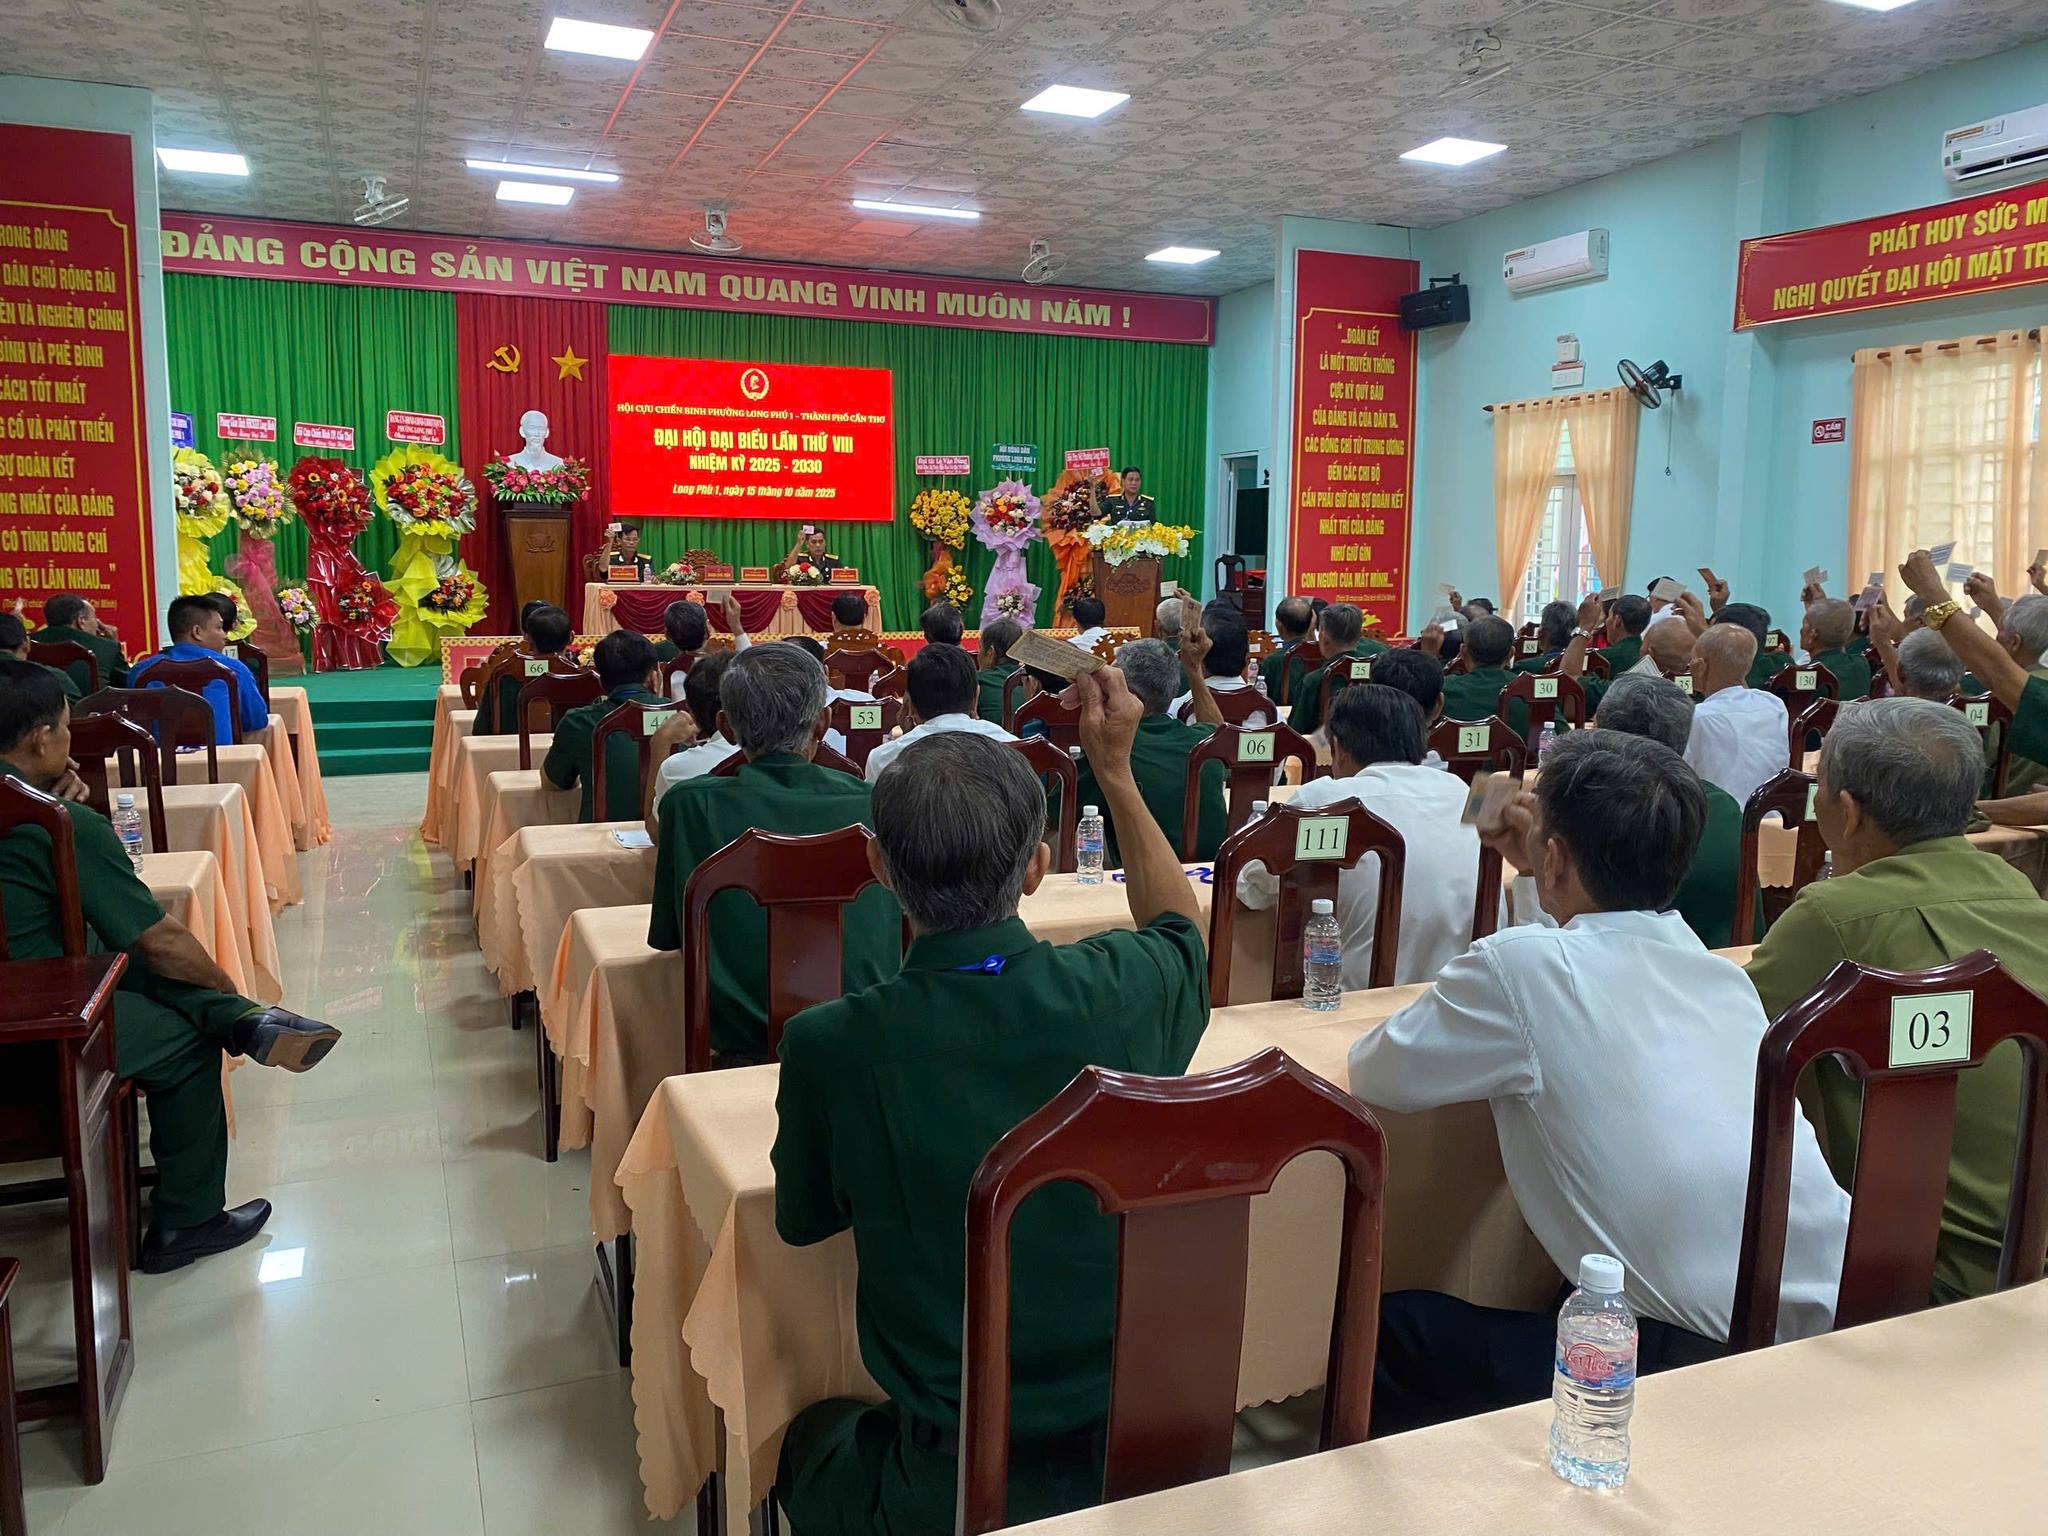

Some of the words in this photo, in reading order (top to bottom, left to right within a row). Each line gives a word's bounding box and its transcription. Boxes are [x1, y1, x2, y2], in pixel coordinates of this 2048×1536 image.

[34, 220, 69, 252] ĐẢNG
[1868, 223, 1920, 256] PHÁT
[1926, 213, 1968, 243] HUY
[1973, 201, 2019, 236] SỨC
[3, 259, 29, 287] DÂN
[32, 259, 56, 289] CHỦ
[59, 263, 93, 295] RỘNG
[95, 266, 117, 293] RÃI
[161, 223, 284, 265] ĐẢNG
[300, 239, 416, 276] CỘNG
[431, 245, 512, 282] SẢN
[526, 257, 609, 293] VIỆT
[622, 266, 706, 296] NAM
[719, 274, 837, 306] QUANG
[848, 284, 925, 313] VINH
[937, 291, 1031, 321] MUÔN
[1041, 298, 1111, 326] NĂM
[1773, 282, 1816, 311] NGHỊ
[1821, 264, 1882, 305] QUYẾT
[1885, 265, 1920, 296] ĐẠI
[1925, 253, 1961, 289] HỘI
[1967, 244, 2017, 282] MẶT
[18, 299, 35, 325] VÀ
[37, 301, 85, 329] NGHIÊM
[88, 301, 125, 331] CHỈNH
[1367, 325, 1380, 346] KẾT
[28, 337, 46, 365] VÀ
[48, 339, 72, 366] PHÊ
[74, 340, 104, 367] BÌNH
[1320, 351, 1329, 370] LÀ
[1330, 351, 1344, 374] MỘT
[1373, 352, 1395, 374] THỐNG
[30, 372, 50, 402] TỐT
[55, 375, 86, 404] NHẤT
[1330, 382, 1344, 402] CỰC
[617, 402, 634, 415] HỘI
[635, 405, 654, 414] CỰU
[655, 402, 683, 415] CHIẾN
[684, 407, 707, 415] BINH
[708, 406, 745, 418] PHƯỜNG
[746, 410, 769, 418] LONG
[770, 409, 789, 420] PHÚ
[801, 411, 831, 421] THÀNH
[832, 411, 849, 422] PHỐ
[850, 411, 868, 423] CẦN
[868, 414, 886, 424] THƠ
[1313, 403, 1326, 425] CỦA
[1328, 405, 1347, 427] ĐẢNG
[1348, 408, 1357, 427] VÀ
[1359, 406, 1372, 427] CỦA
[1374, 409, 1387, 428] DÂN
[27, 413, 44, 440] VÀ
[46, 415, 76, 441] PHÁT
[79, 412, 115, 443] TRIỂN
[654, 428, 678, 450] ĐẠI
[683, 426, 706, 451] HỘI
[710, 430, 734, 452] ĐẠI
[738, 428, 768, 450] BIỂU
[772, 430, 798, 451] LẦN
[802, 431, 829, 452] THỨ
[832, 435, 854, 454] VIII
[1305, 434, 1319, 452] CÁC
[1341, 435, 1352, 454] CHÍ
[1353, 435, 1363, 454] TỪ
[1364, 439, 1384, 455] TRUNG
[1386, 438, 1404, 455] ƯƠNG
[16, 451, 49, 478] ĐOÀN
[52, 450, 75, 479] KẾT
[689, 453, 728, 473] NHIỆM
[731, 453, 746, 471] KỲ
[750, 459, 780, 472] 2025
[792, 459, 823, 474] 2030
[1328, 460, 1342, 481] ĐẾN
[1343, 462, 1357, 481] CÁC
[1359, 466, 1370, 482] CHI
[1371, 463, 1380, 485] BỘ
[20, 486, 51, 515] NHẤT
[54, 487, 79, 516] CỦA
[81, 487, 114, 517] ĐẢNG
[672, 483, 695, 495] Long
[696, 483, 713, 495] Phú
[723, 486, 745, 497] ngày
[747, 486, 756, 496] 15
[757, 485, 783, 498] tháng
[784, 486, 793, 497] 10
[794, 486, 813, 497] năm
[815, 487, 836, 498] 2025
[1318, 487, 1333, 508] PHẢI
[1335, 489, 1347, 508] GIỮ
[1348, 489, 1360, 508] GÌN
[1361, 491, 1371, 511] SỰ
[1372, 490, 1390, 508] ĐOÀN
[1391, 488, 1404, 509] KẾT
[1320, 514, 1337, 535] NHẤT
[1339, 516, 1350, 535] TRÍ
[1351, 514, 1365, 535] CỦA
[1366, 514, 1384, 535] ĐẢNG
[2, 525, 18, 551] CÓ
[20, 525, 49, 552] TÌNH
[51, 524, 85, 553] ĐỒNG
[87, 527, 108, 553] CHÍ
[1331, 545, 1346, 561] NHƯ
[1346, 543, 1358, 561] GIỮ
[1359, 543, 1371, 561] GÌN
[15, 563, 39, 589] YÊU
[41, 559, 65, 589] LẪN
[1301, 572, 1316, 588] CON
[1339, 567, 1353, 588] CỦA
[1354, 567, 1369, 587] MẮT
[529, 663, 545, 674] 66
[1355, 665, 1366, 676] 25
[1539, 683, 1553, 695] 30
[857, 711, 875, 725] 53
[1970, 709, 1984, 722] 04
[1247, 738, 1267, 756] 06
[1465, 732, 1482, 748] 31
[1303, 828, 1339, 851] 111
[1908, 1010, 1951, 1050] 03
